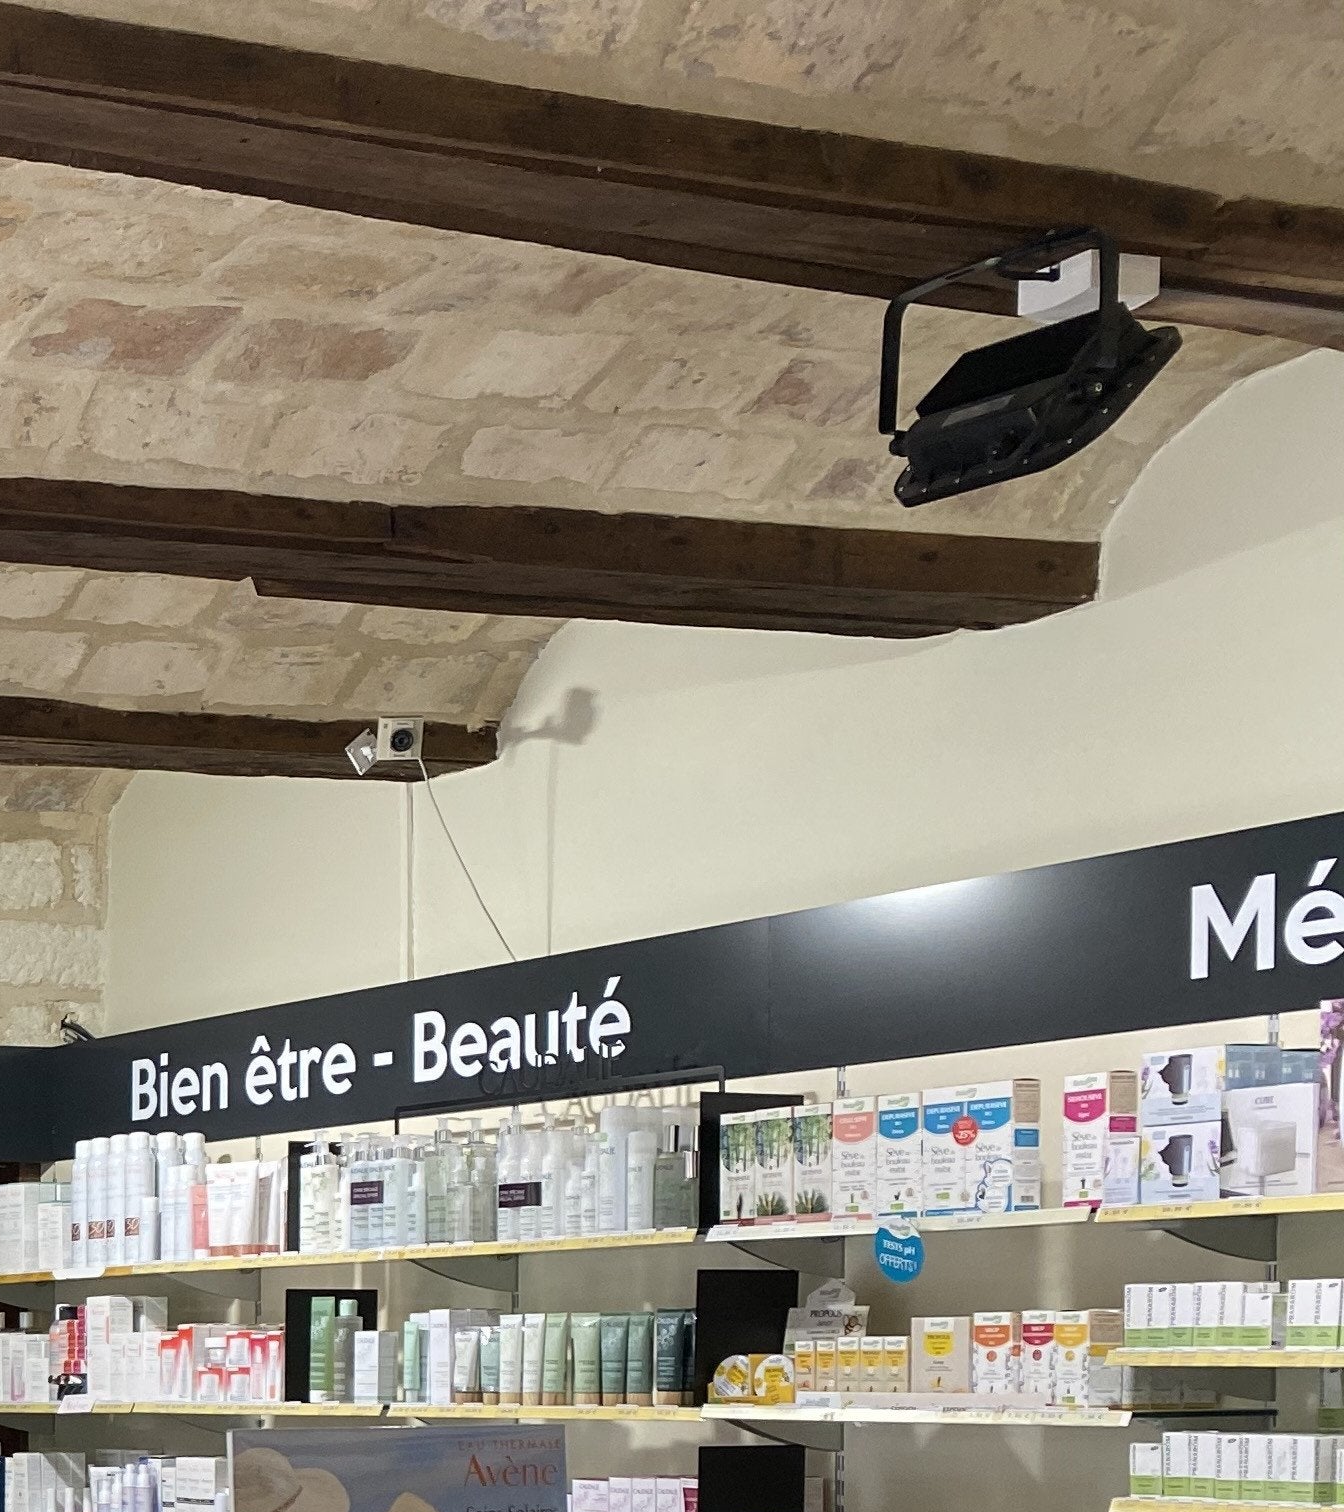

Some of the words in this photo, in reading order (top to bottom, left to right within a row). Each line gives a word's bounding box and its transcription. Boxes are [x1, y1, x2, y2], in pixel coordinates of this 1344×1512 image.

[131, 1057, 229, 1122] Bien
[245, 1036, 357, 1106] être
[413, 976, 632, 1083] Beauté
[464, 1454, 560, 1488] Avène
